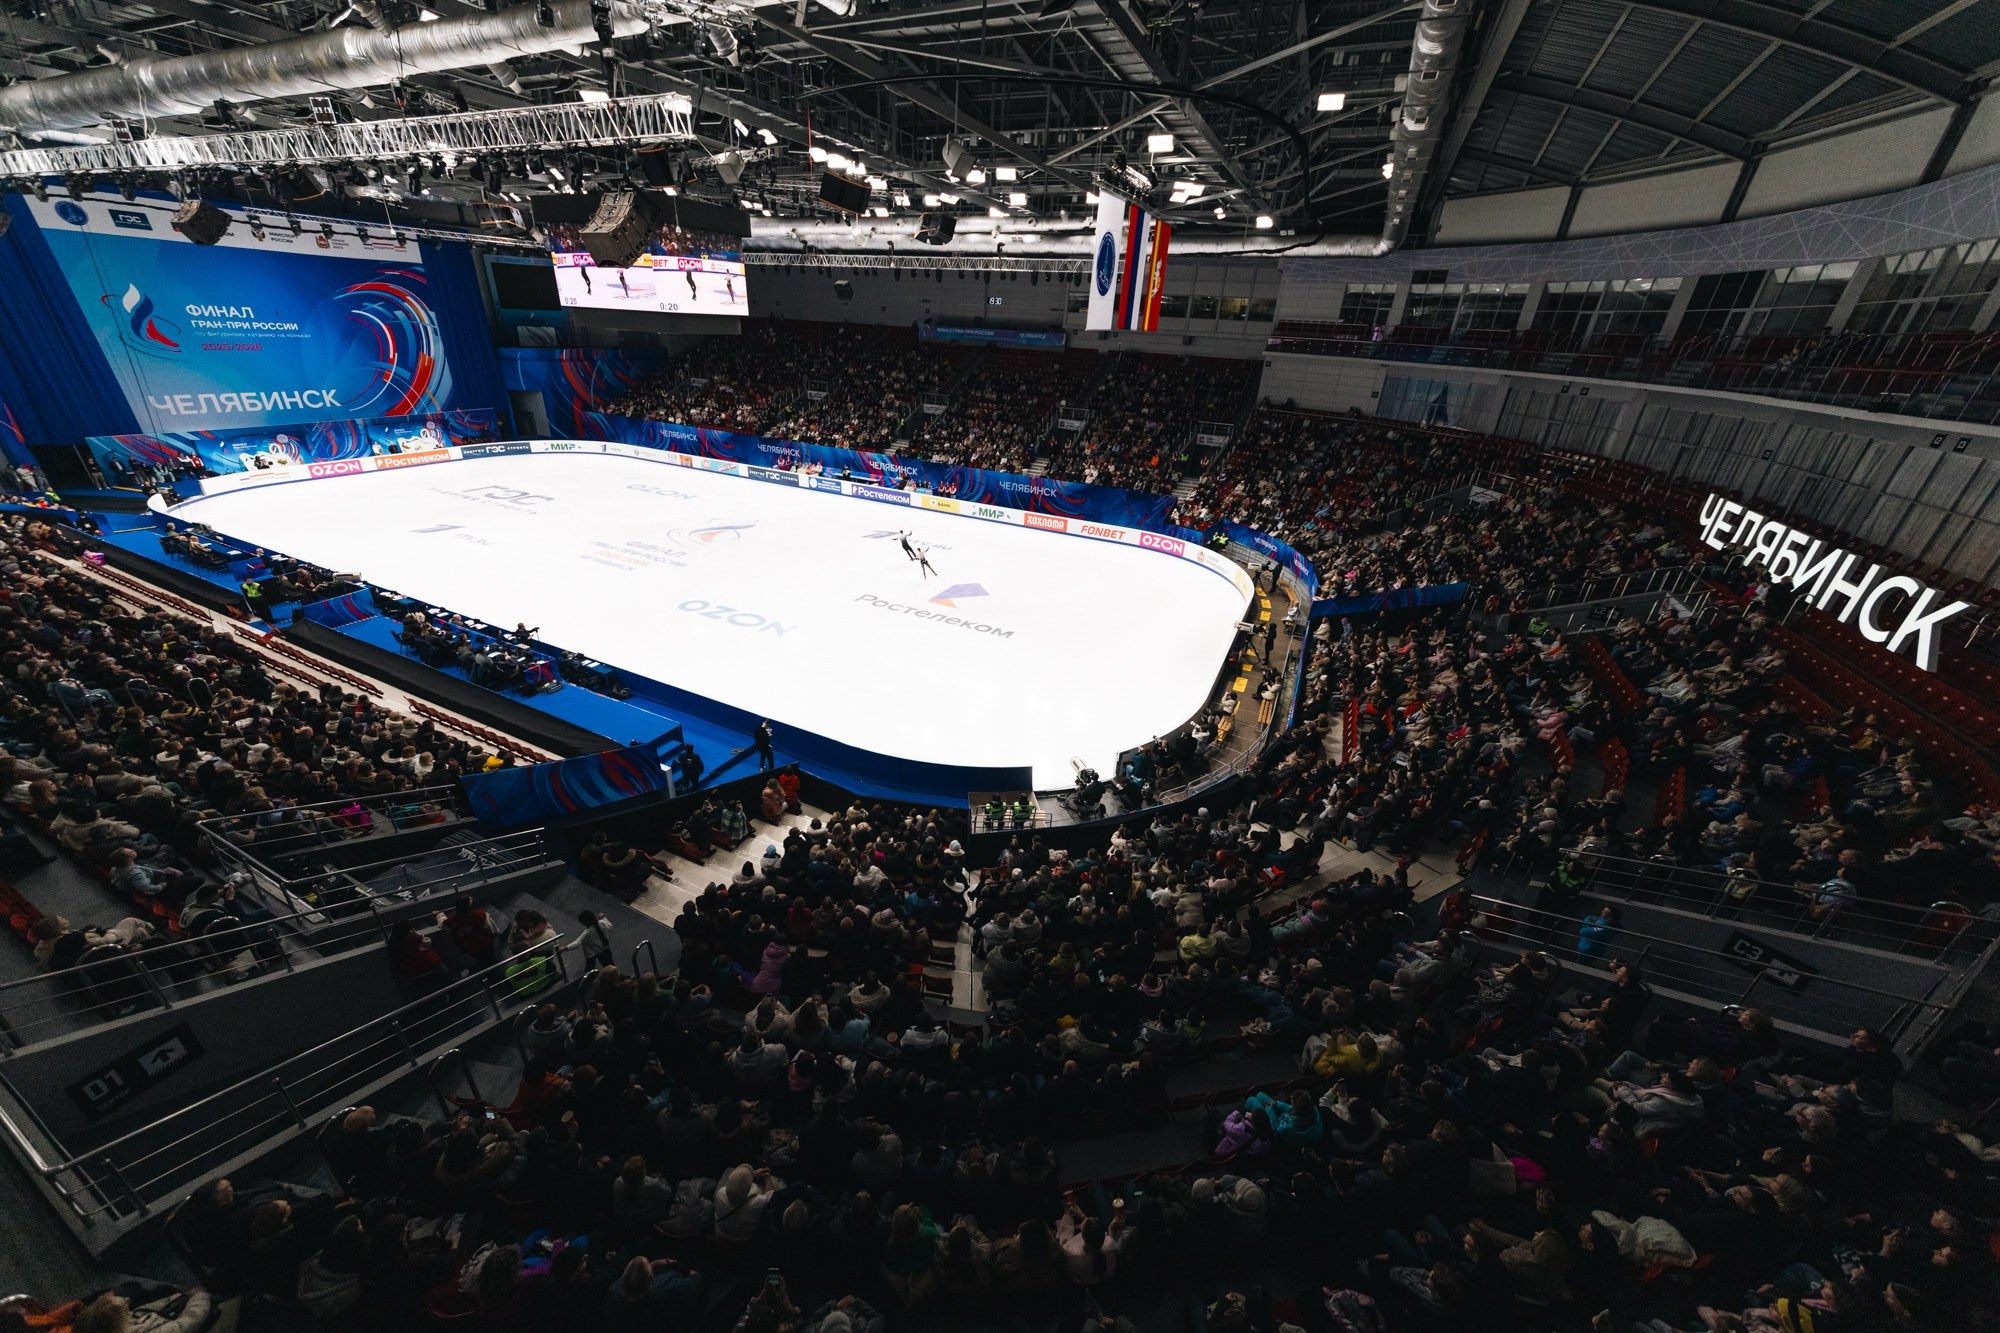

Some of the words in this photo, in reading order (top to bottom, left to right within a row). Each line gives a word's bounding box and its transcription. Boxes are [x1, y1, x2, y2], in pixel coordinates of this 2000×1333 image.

[185, 304, 254, 319] ФИНАЛ
[659, 302, 679, 311] 0:20
[191, 320, 251, 330] ГРАН-ПРИ
[252, 321, 299, 331] РОССИИ
[202, 343, 262, 352] 2025/2026
[148, 389, 342, 416] ЧЕЛЯБИНСК
[660, 429, 698, 442] ЧЕЛЯБИНСК
[486, 445, 506, 454] ГЭС
[551, 443, 575, 451] МИР
[757, 443, 801, 458] ЧЕЛЯБИНСК
[385, 452, 450, 467] Ростелеком
[311, 461, 360, 476] OZON
[765, 471, 781, 481] ГЭС
[869, 460, 918, 477] ЧЕЛЯБИНСК
[461, 485, 555, 506] ГЭС
[626, 483, 699, 500] OZON
[858, 487, 910, 504] Ростелеком
[1000, 481, 1057, 498] ЧЕЛЯБИНСК
[978, 507, 1004, 519] МИР
[1027, 515, 1064, 530] ХОХЛОМА
[1080, 525, 1126, 540] FONBET
[626, 540, 688, 558] ФИНАЛ
[1142, 534, 1184, 555] OZON
[1699, 493, 1971, 672] ЧЕЛЯБИНСК
[677, 599, 799, 638] OZON
[854, 594, 1015, 639] Ростелеком
[1732, 939, 1764, 961] C3
[83, 1069, 125, 1102] D1
